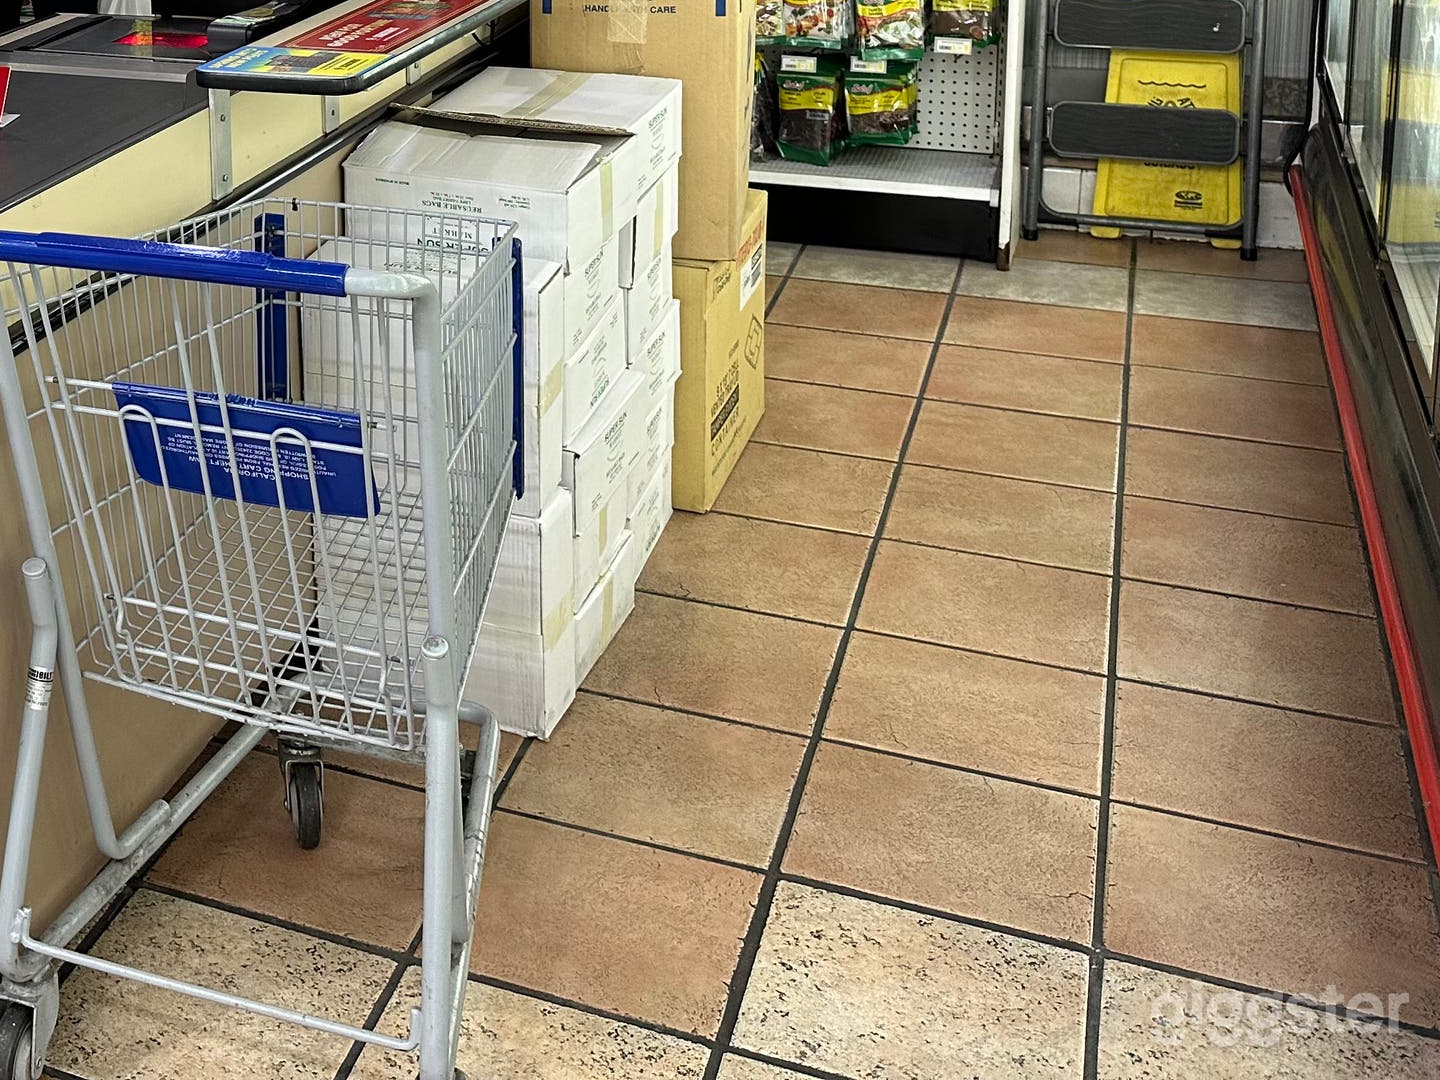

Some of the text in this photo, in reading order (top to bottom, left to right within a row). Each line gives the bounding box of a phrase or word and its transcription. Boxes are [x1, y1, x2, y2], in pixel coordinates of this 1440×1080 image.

[650, 5, 676, 14] CARE
[422, 200, 482, 214] REUSABLE BAGS
[238, 463, 262, 472] CART
